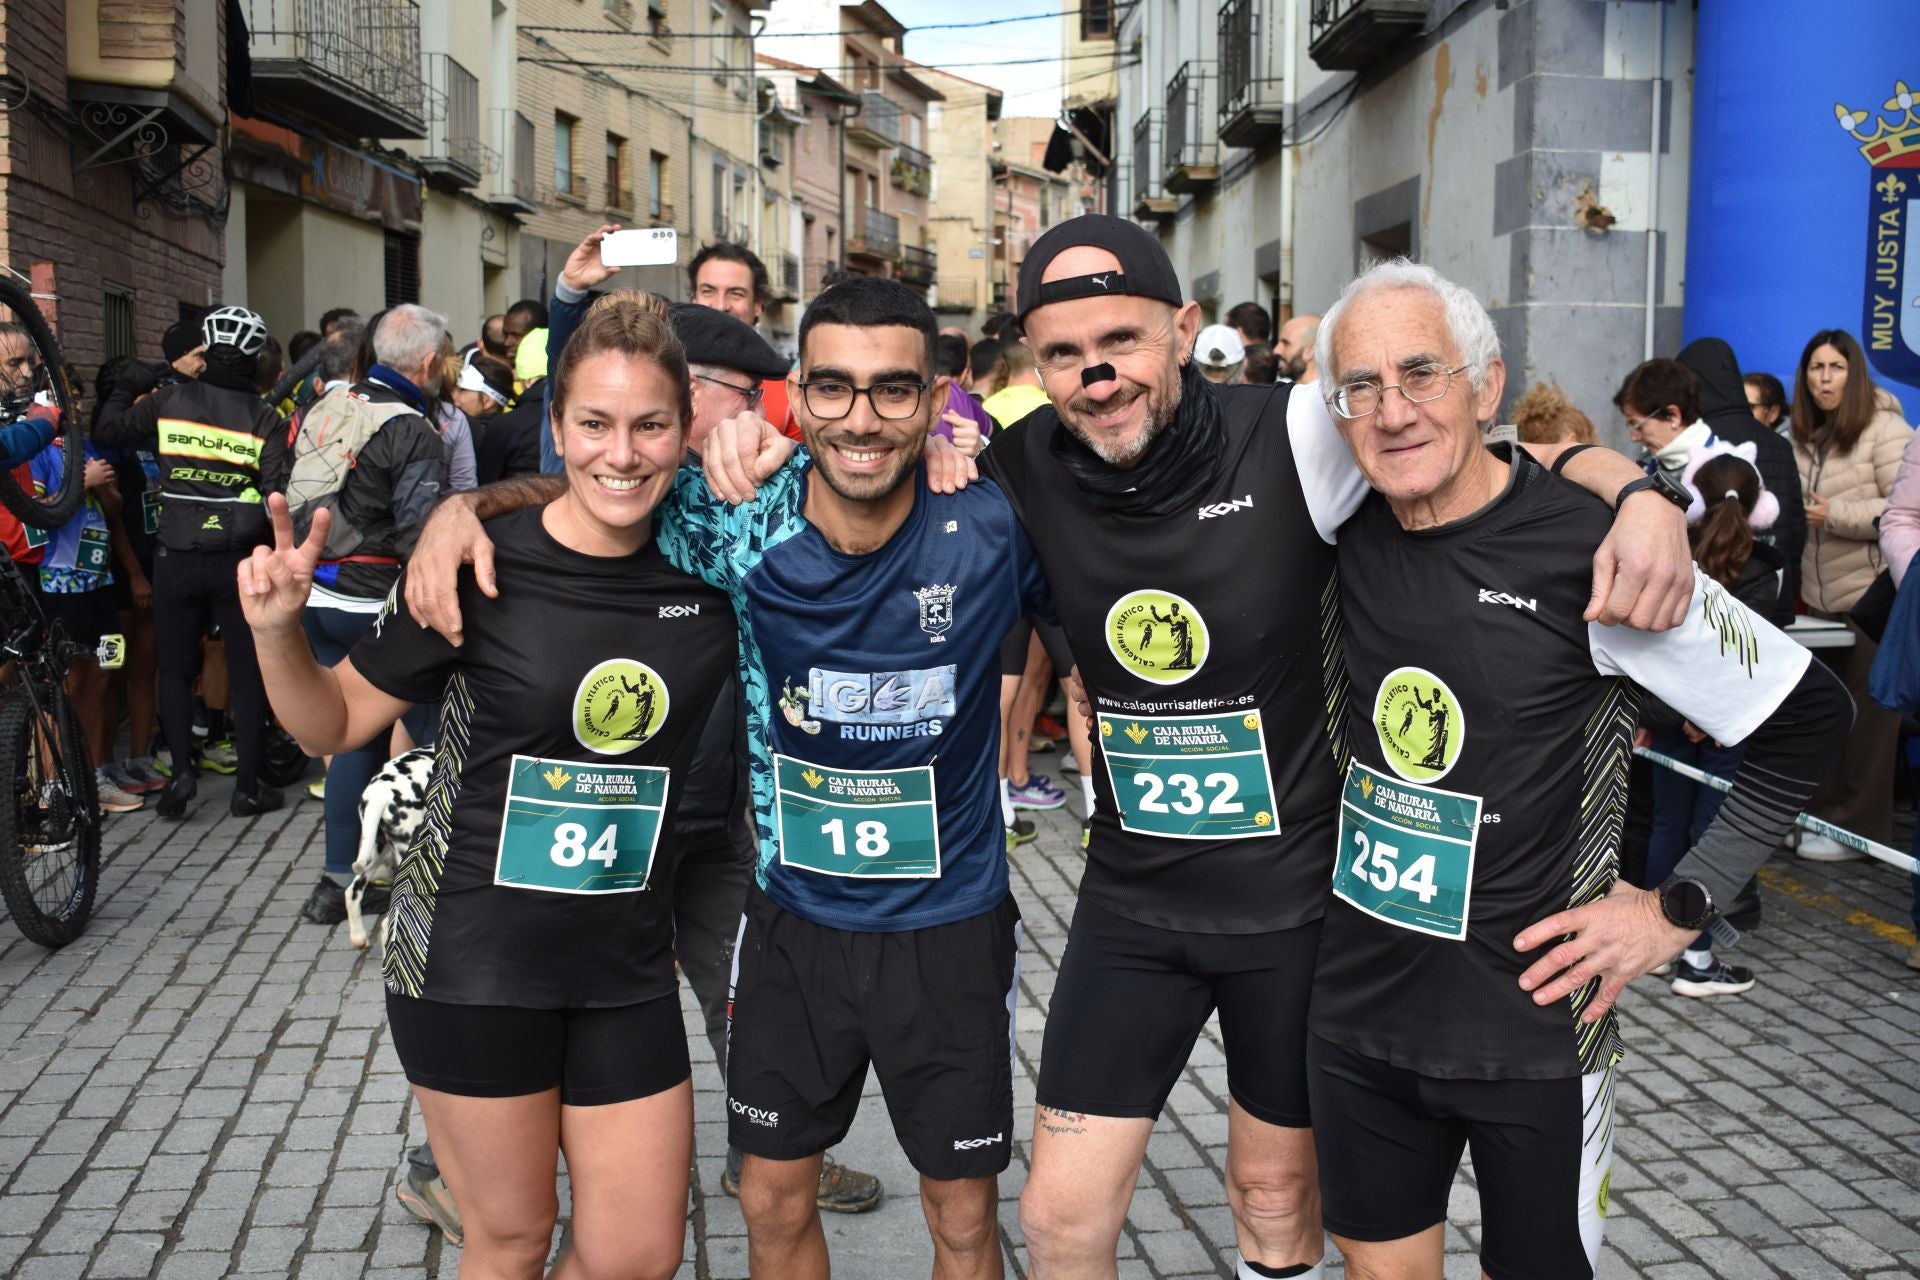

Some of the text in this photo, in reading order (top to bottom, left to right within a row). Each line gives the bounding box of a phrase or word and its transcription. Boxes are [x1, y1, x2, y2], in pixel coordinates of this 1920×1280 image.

[1872, 208, 1901, 350] MUY JUSTA
[167, 433, 257, 458] sanbikes
[1117, 605, 1144, 630] ATLETICO
[585, 675, 615, 704] ATLETICO
[1383, 684, 1409, 711] ATLETICO
[840, 719, 943, 742] RUNNERS
[1152, 724, 1221, 736] CAJA RURAL
[1154, 734, 1229, 746] DE NAVARRA
[575, 783, 638, 795] DE NAVARRA
[576, 773, 636, 785] CAJA RURAL
[828, 776, 896, 787] CAJA RURAL
[829, 785, 902, 796] DE NAVARRA
[1133, 772, 1244, 815] 232
[1375, 784, 1437, 811] CAJA RURAL
[1374, 795, 1442, 824] DE NAVARRA
[821, 818, 890, 858] 18
[1415, 821, 1441, 832] SOCIAL
[1815, 821, 1828, 837] DE
[550, 822, 618, 868] 84
[1351, 830, 1438, 904] 254
